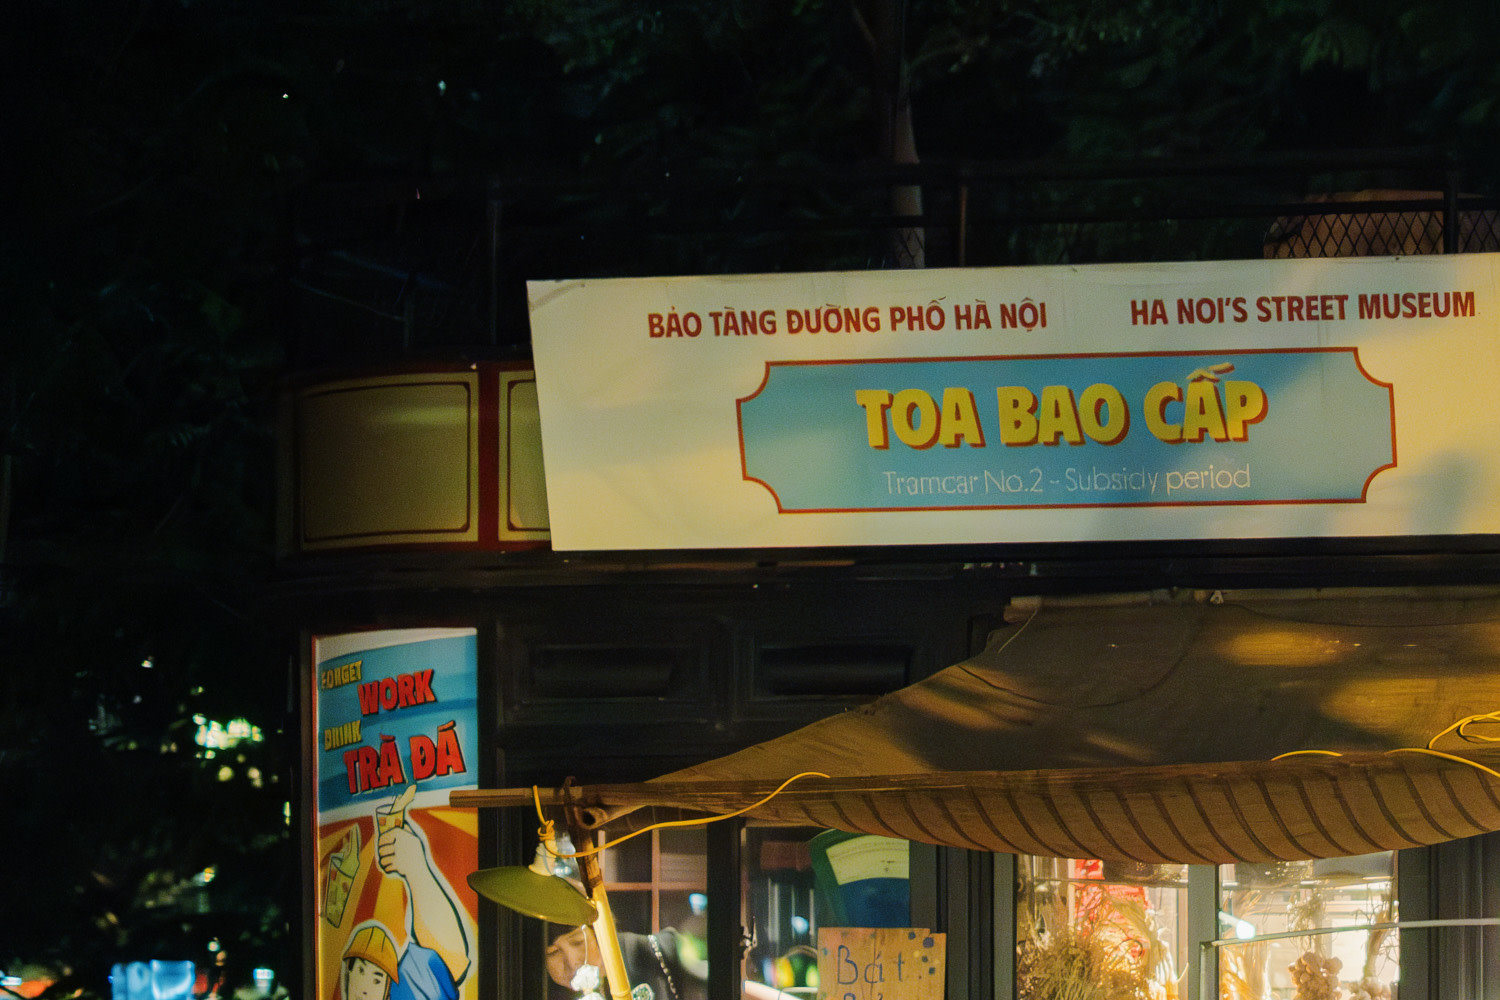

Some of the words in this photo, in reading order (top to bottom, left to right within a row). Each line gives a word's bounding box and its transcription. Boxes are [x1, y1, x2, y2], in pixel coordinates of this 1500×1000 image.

[648, 306, 702, 338] BẢO
[709, 306, 776, 336] TÀNG
[786, 304, 881, 335] ĐƯỜNG
[890, 297, 946, 332] PHỐ
[955, 299, 992, 330] HÀ
[1001, 297, 1047, 332] NỘI
[1131, 299, 1168, 325] HA
[1177, 297, 1248, 324] NOI'S
[1256, 295, 1348, 321] STREET
[1358, 291, 1475, 319] MUSEUM
[855, 387, 986, 450] TOA
[996, 383, 1130, 446] BAO
[1144, 362, 1268, 444] CẤP
[883, 471, 979, 495] Tramcar
[985, 468, 1044, 493] No.2
[1065, 467, 1159, 495] Subsidy
[1166, 463, 1251, 495] period
[321, 660, 362, 689] FORGET
[358, 669, 437, 716] WORK
[324, 720, 362, 751] DRINK
[344, 734, 404, 794] TRÀ
[409, 720, 466, 781] ĐÁ
[837, 945, 905, 984] Bát
